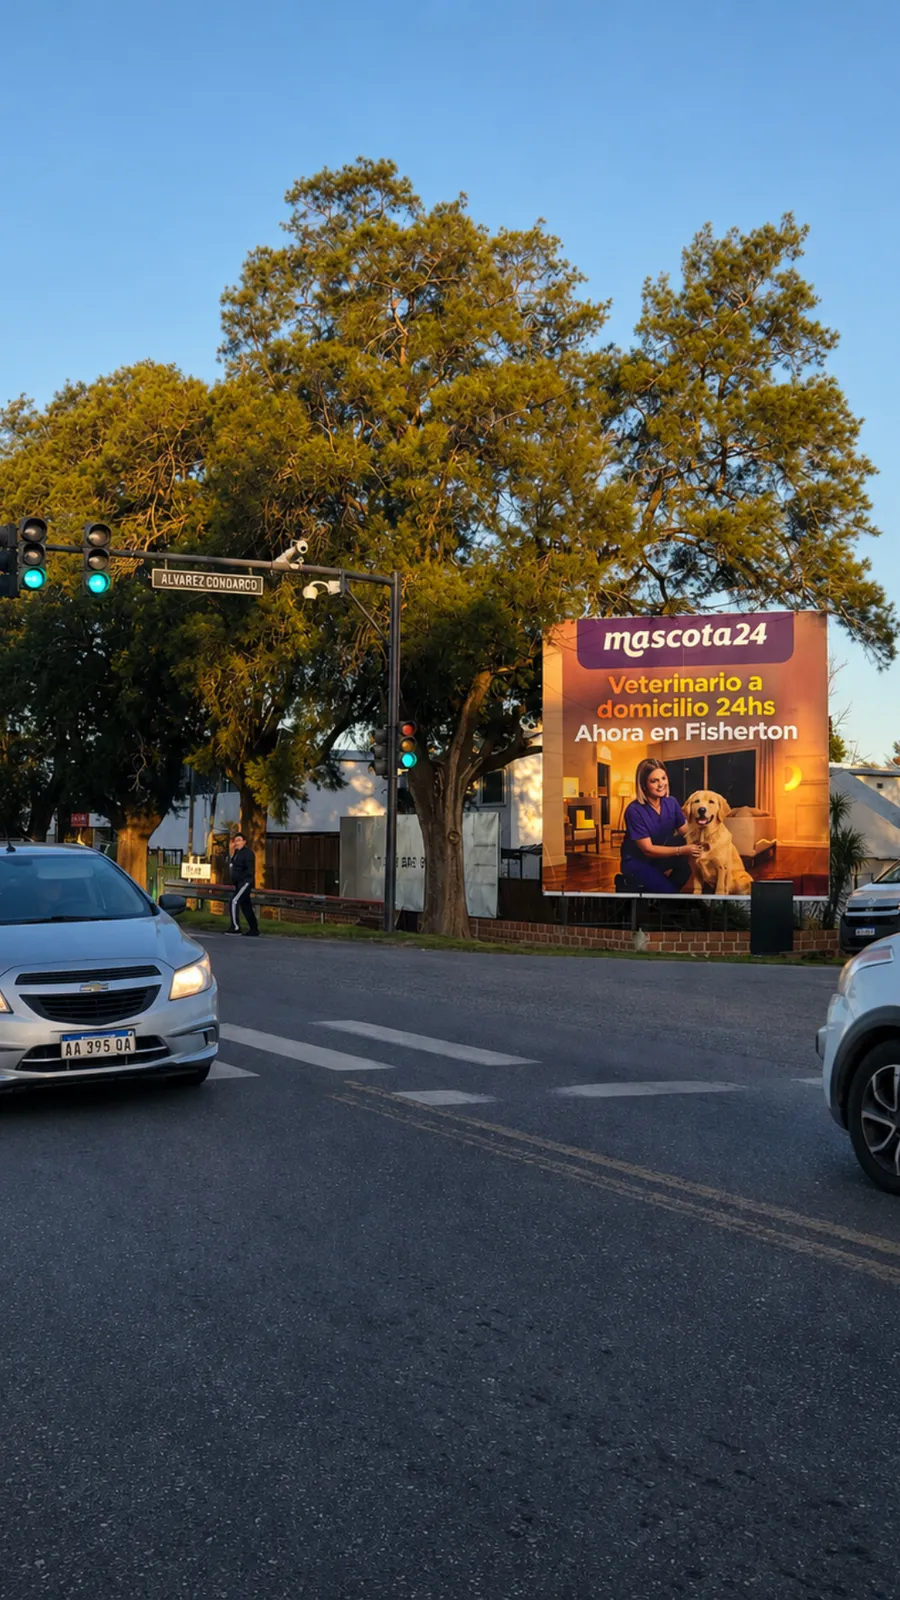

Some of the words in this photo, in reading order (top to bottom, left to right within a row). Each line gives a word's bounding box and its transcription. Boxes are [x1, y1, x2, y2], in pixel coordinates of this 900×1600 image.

[161, 573, 204, 587] ALVAREZ
[206, 576, 258, 591] CONDARCO
[603, 622, 767, 658] mascota24
[608, 672, 742, 694] Veterinario
[748, 674, 763, 692] a
[597, 698, 709, 719] domicilio
[716, 696, 775, 717] 24hs
[574, 724, 644, 742] Ahora
[650, 726, 679, 742] en
[685, 721, 798, 742] Fisherton
[65, 1042, 81, 1056] AA
[87, 1039, 110, 1054] 395
